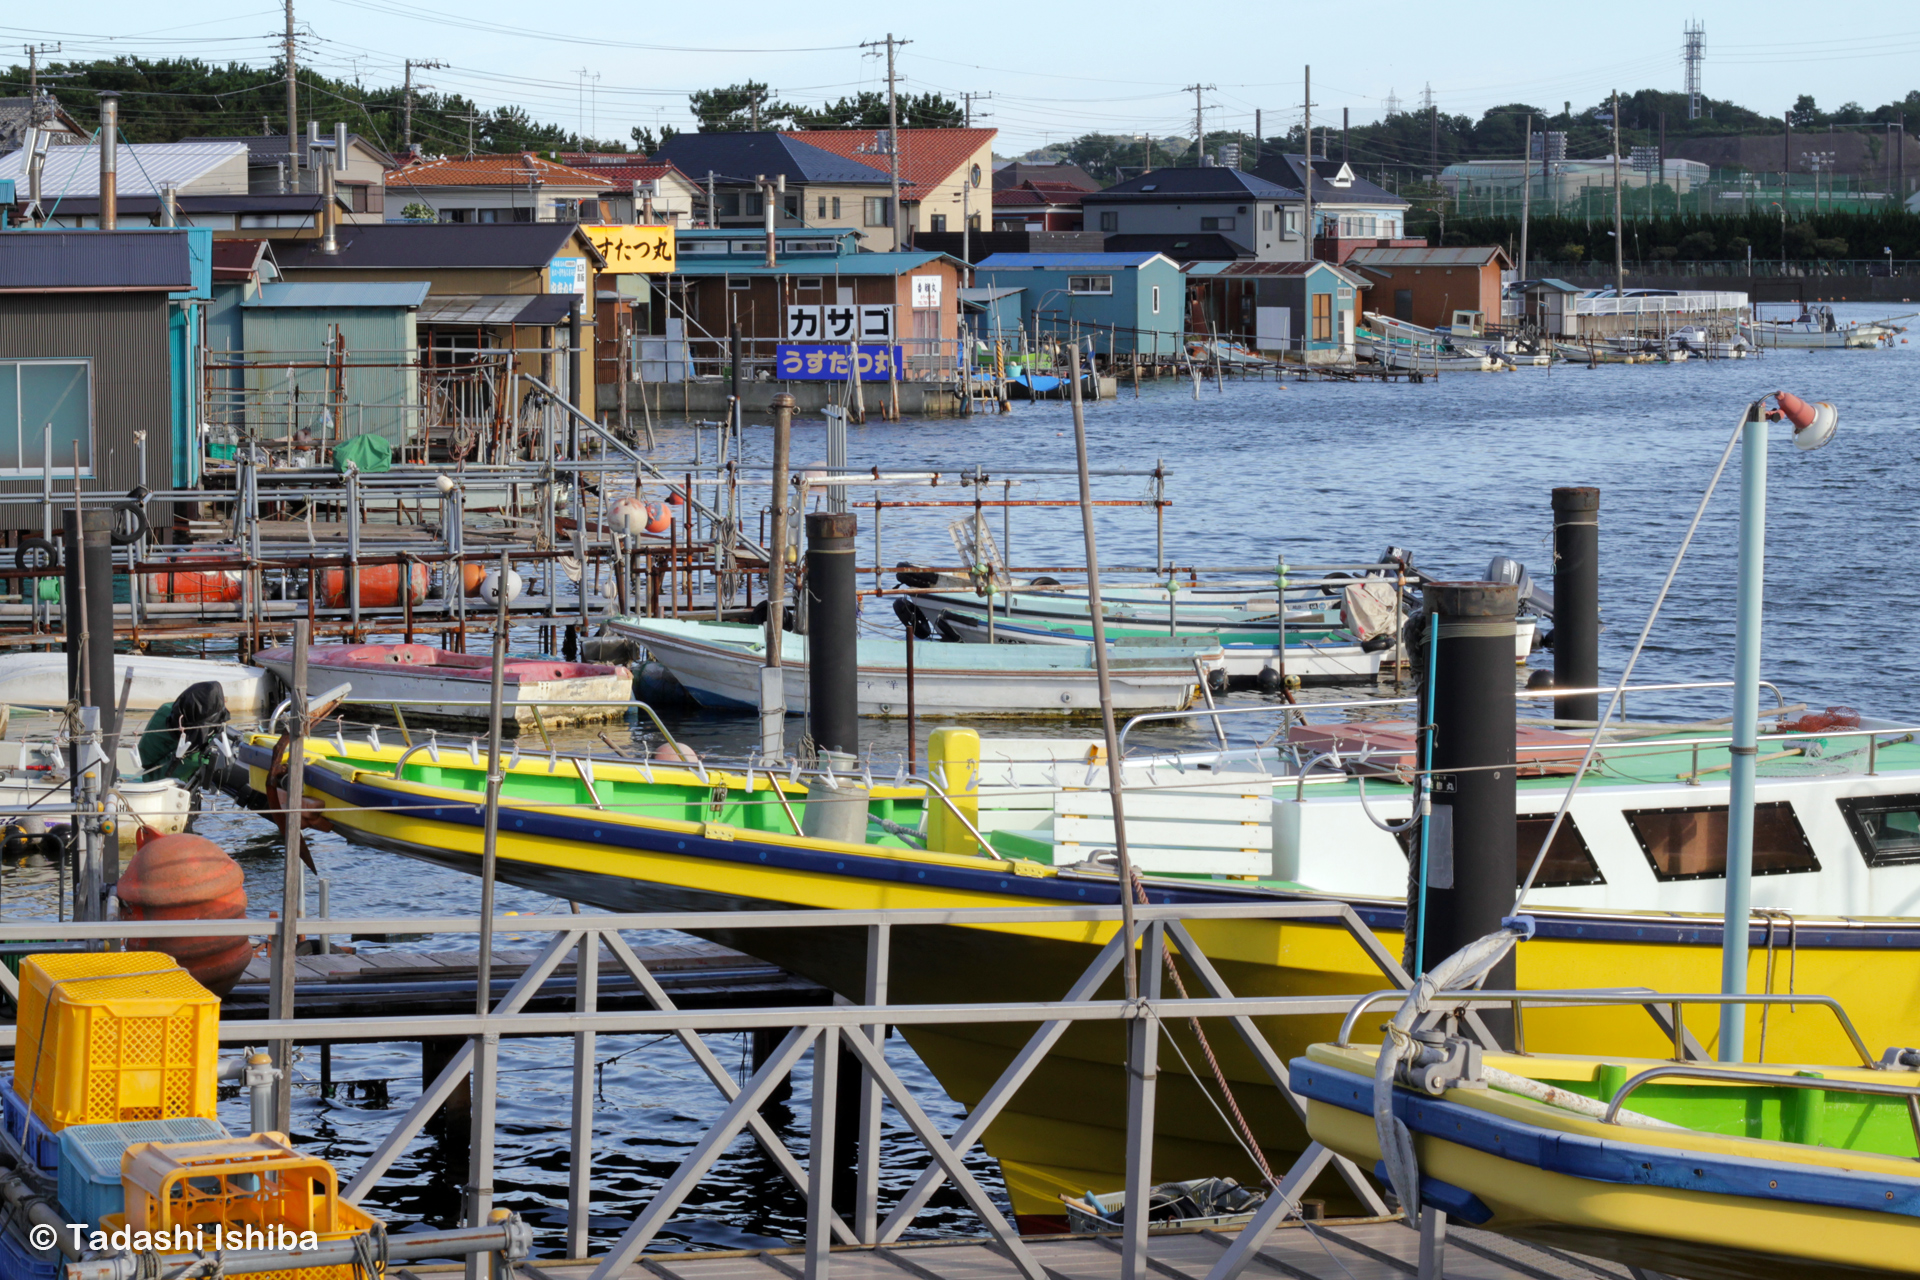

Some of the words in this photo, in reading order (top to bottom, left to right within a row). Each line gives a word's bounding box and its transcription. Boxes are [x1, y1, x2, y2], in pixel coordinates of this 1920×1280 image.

[588, 237, 672, 261] すたつ丸
[790, 307, 890, 337] カサゴ
